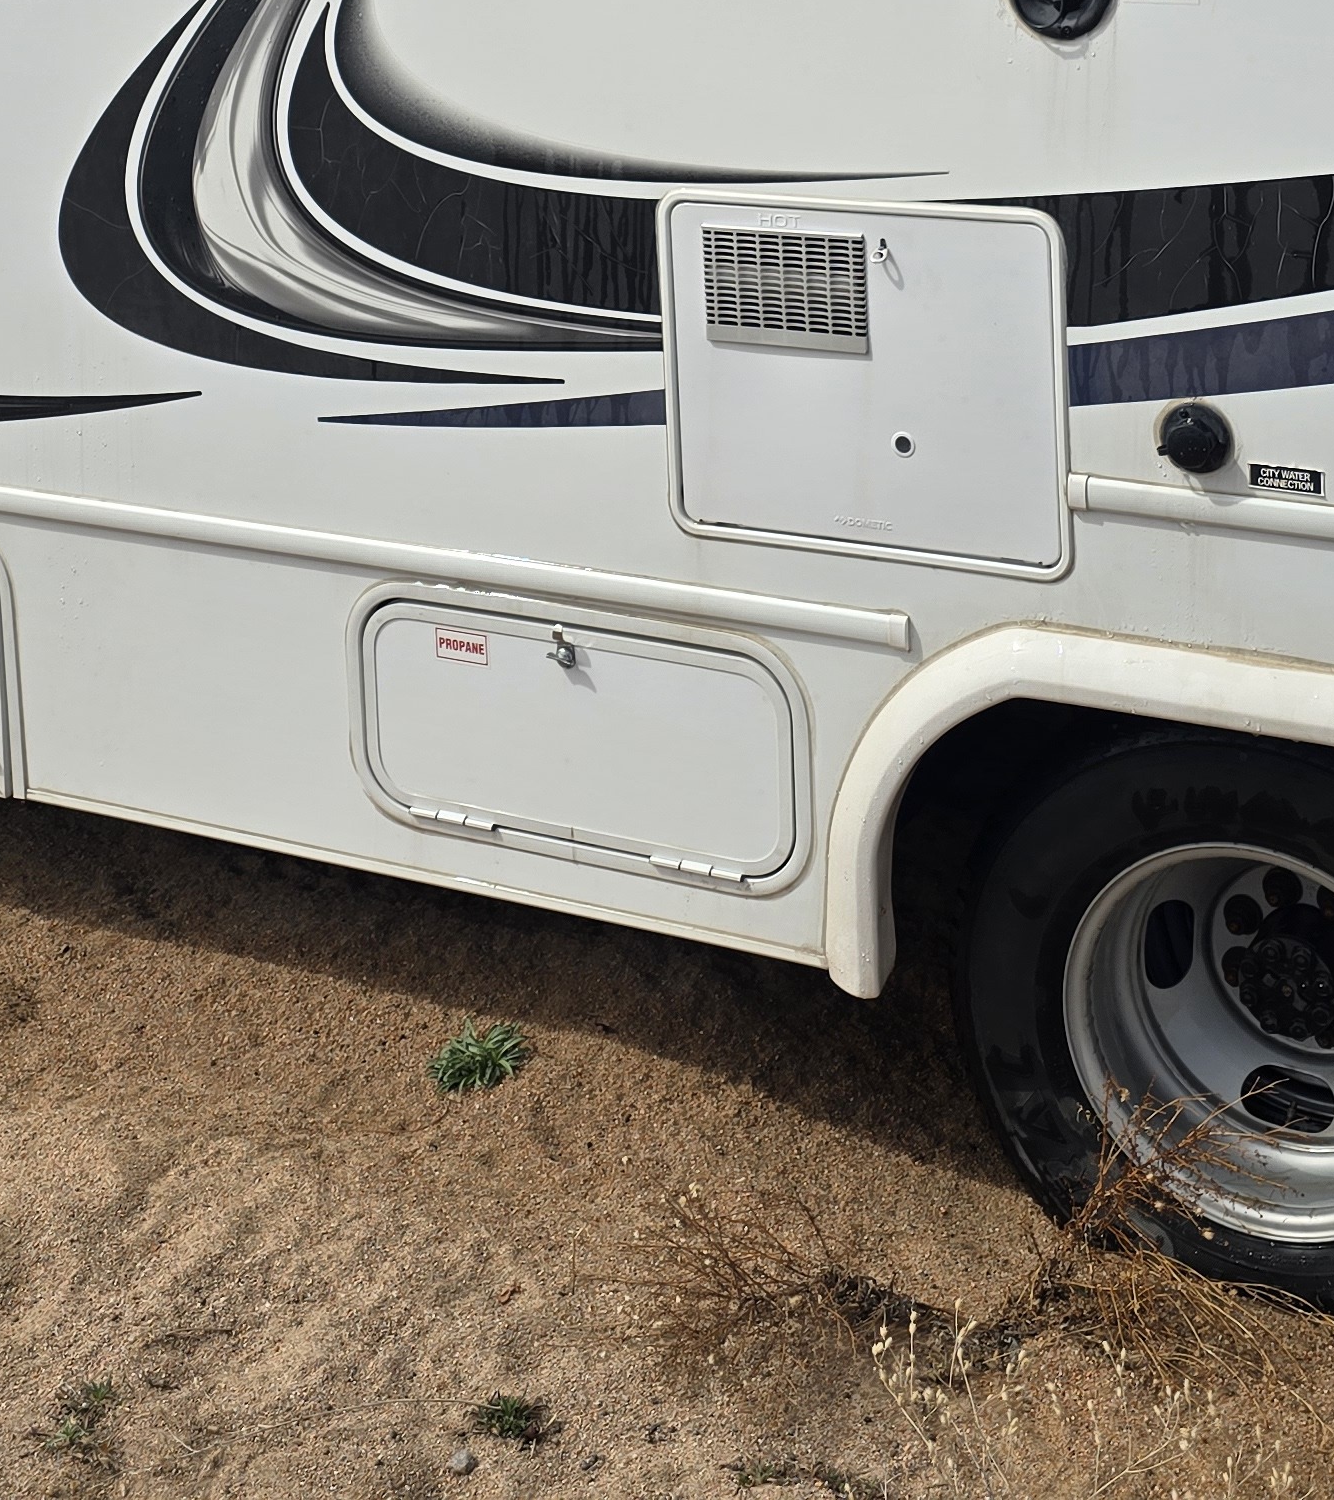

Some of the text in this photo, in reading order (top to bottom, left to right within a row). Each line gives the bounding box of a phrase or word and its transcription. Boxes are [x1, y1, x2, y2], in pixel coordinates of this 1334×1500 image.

[757, 213, 801, 228] HOT
[1260, 468, 1311, 481] CITY WATER
[1257, 477, 1314, 491] CONNECTION
[438, 637, 485, 655] PROPANE
